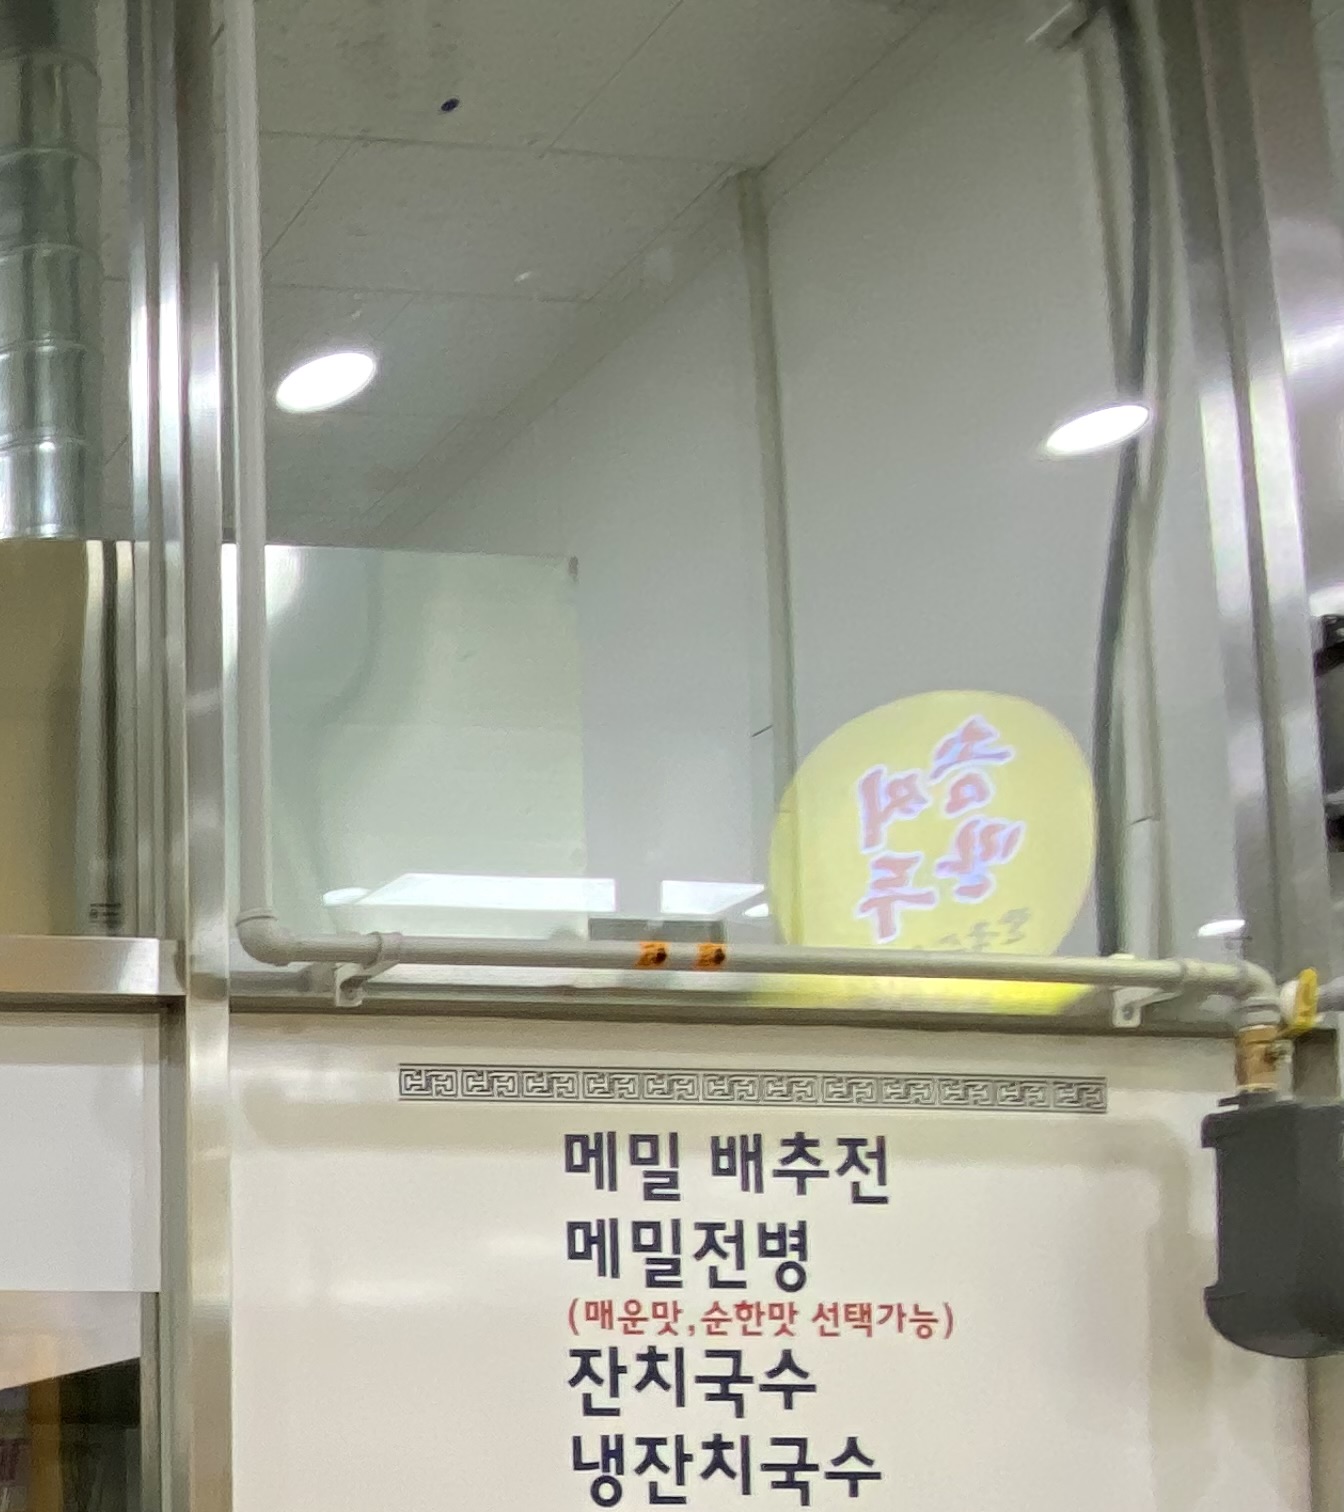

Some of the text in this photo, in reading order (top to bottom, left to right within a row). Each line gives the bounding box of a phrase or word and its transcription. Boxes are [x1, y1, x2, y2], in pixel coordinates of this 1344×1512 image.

[564, 1131, 889, 1205] 메밀 배추전
[567, 1219, 810, 1293] 메밀전병
[813, 1303, 955, 1340] 선택가능)
[568, 1346, 816, 1419] 잔치국수
[572, 1433, 882, 1507] 냉잔치국수
